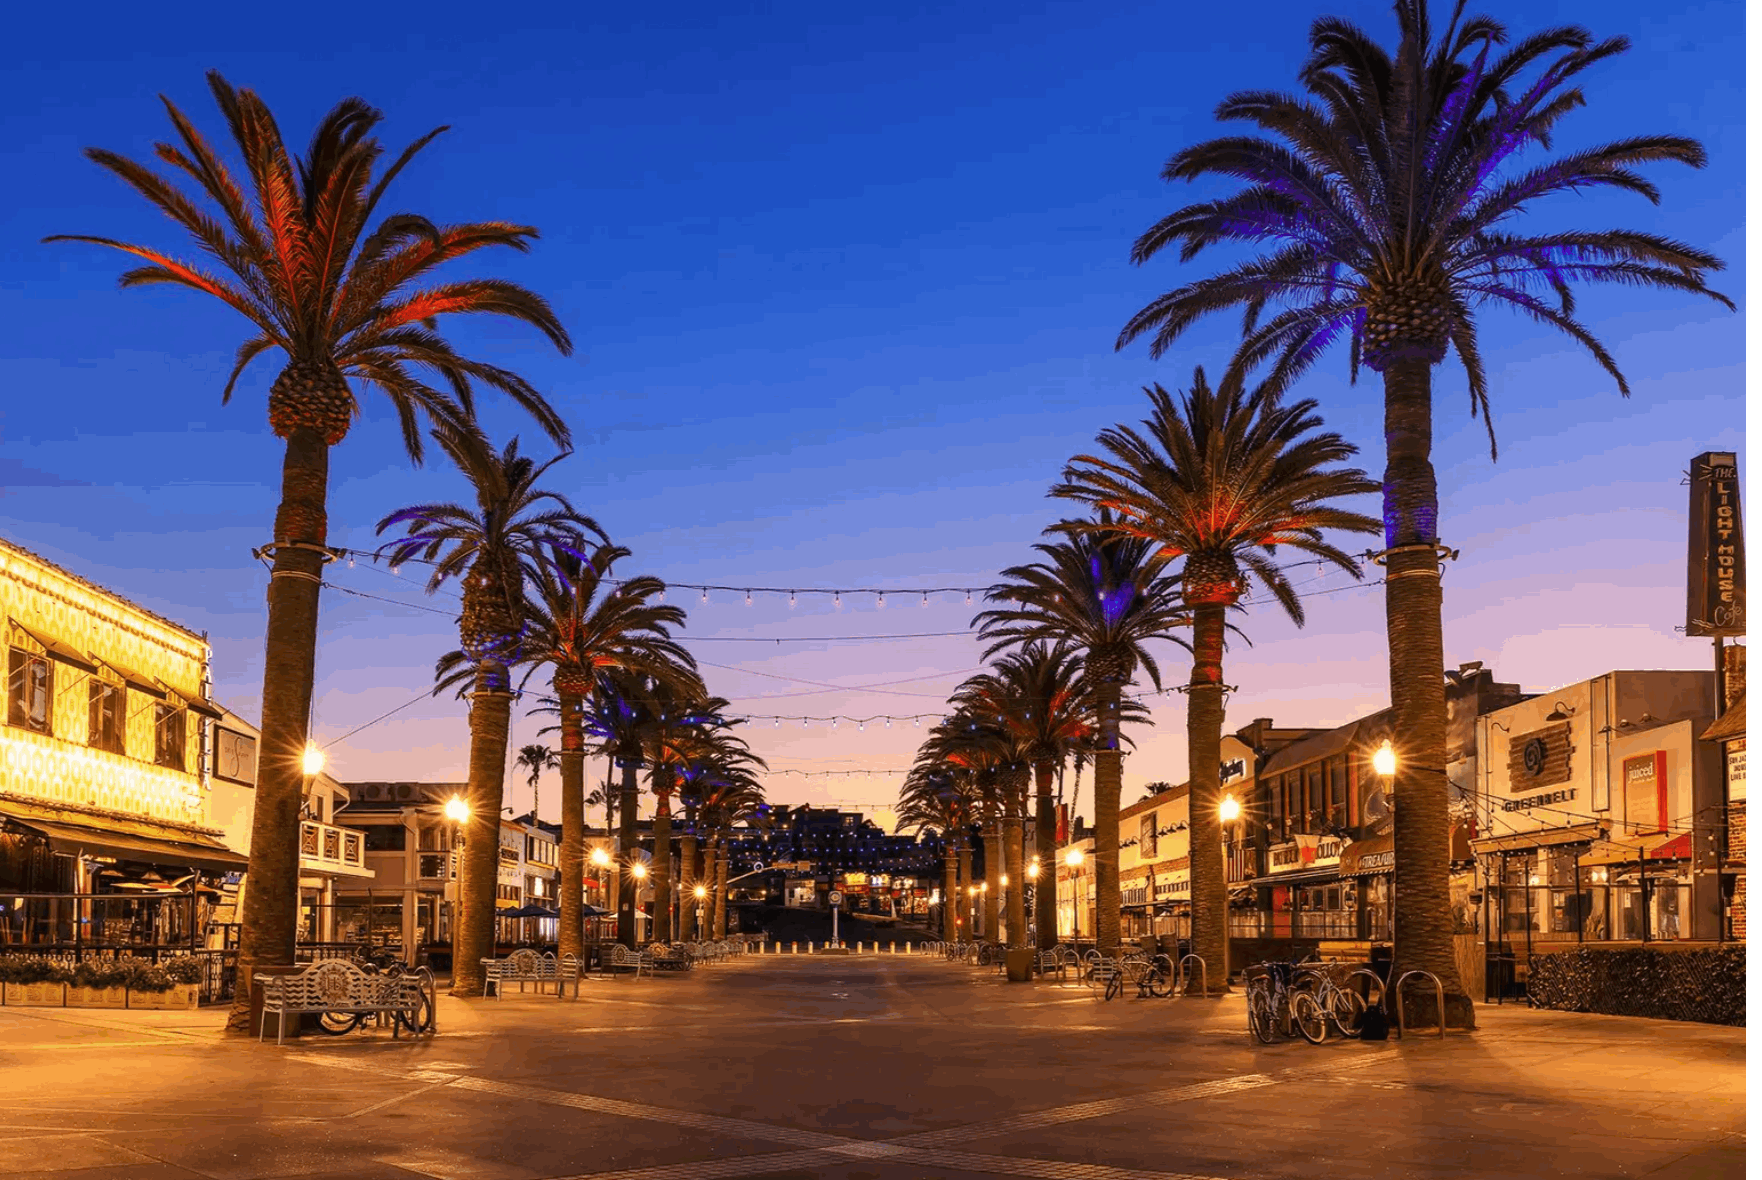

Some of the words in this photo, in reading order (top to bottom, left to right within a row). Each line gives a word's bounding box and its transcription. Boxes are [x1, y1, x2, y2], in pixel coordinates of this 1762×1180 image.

[1715, 467, 1735, 478] THE
[1714, 600, 1743, 627] Cafe
[1628, 761, 1653, 784] juiced
